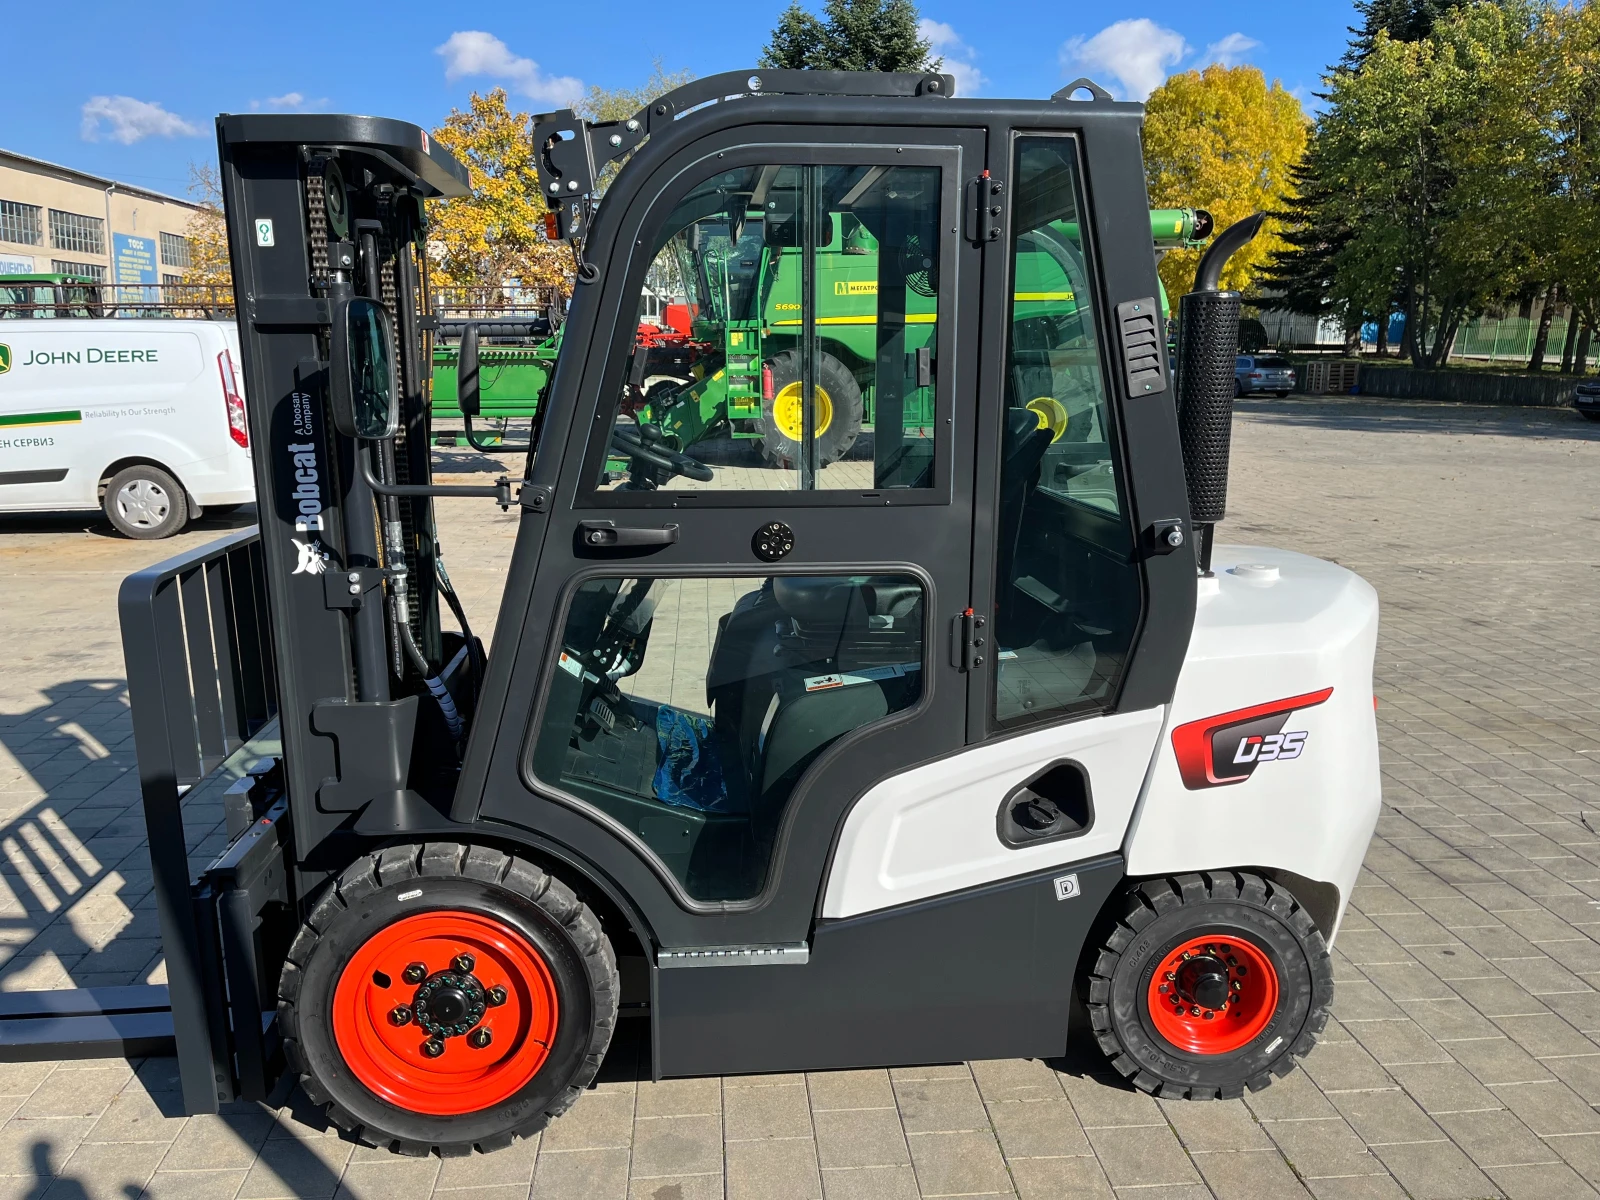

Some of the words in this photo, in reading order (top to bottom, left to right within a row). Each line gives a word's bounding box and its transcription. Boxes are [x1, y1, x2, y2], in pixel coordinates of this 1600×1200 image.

[23, 350, 81, 366] JOHN
[87, 348, 159, 363] DEERE
[143, 406, 176, 415] Strength
[291, 392, 303, 427] Doosan
[303, 392, 314, 436] Company
[13, 437, 55, 447] СЕРВИЗ
[294, 427, 304, 436] A
[287, 443, 325, 532] Bobcat
[1233, 731, 1309, 764] D35
